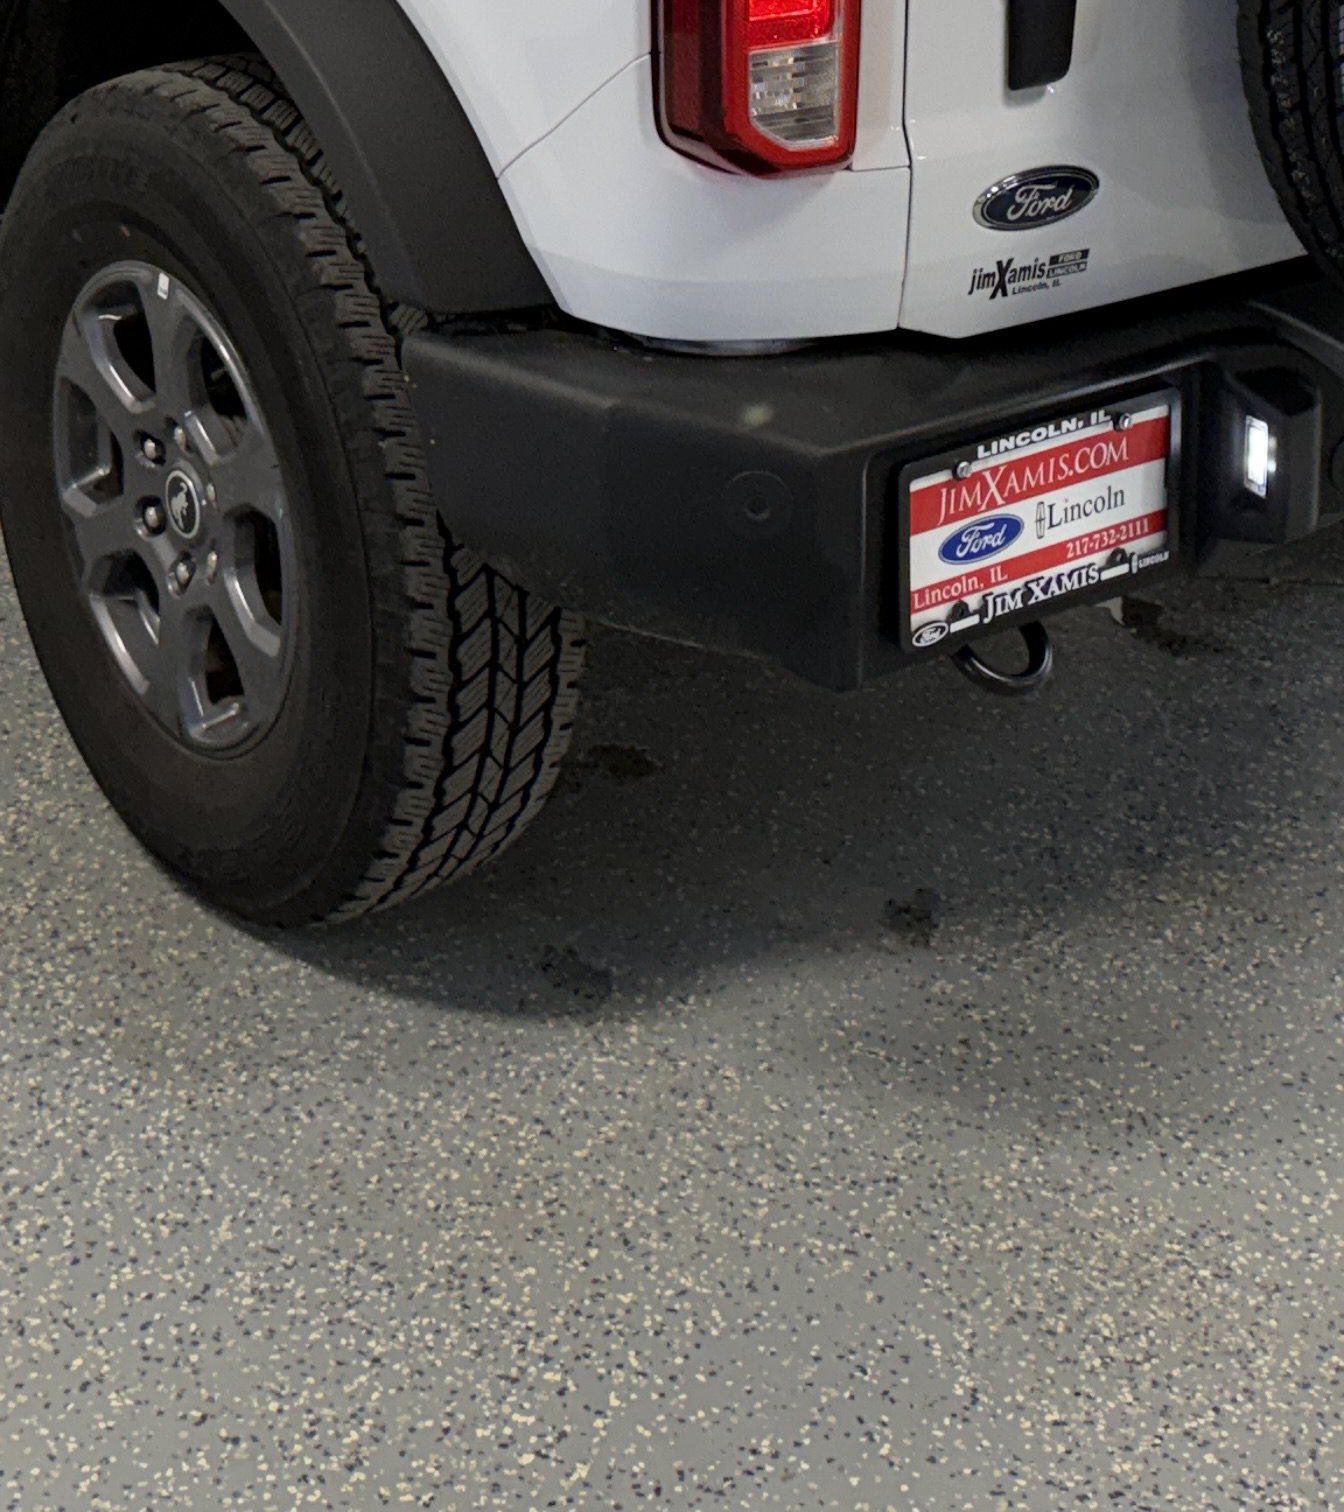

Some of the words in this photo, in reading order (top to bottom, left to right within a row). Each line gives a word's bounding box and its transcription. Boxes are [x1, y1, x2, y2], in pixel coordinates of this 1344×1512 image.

[1008, 182, 1076, 221] Ford
[977, 415, 1085, 459] LINCOLN,
[1090, 408, 1112, 425] IL
[937, 436, 1130, 526] JIMXAMIS.COM
[1046, 484, 1126, 530] Lincoln
[955, 522, 1006, 557] Ford
[1066, 518, 1150, 559] 217-732-2111
[912, 572, 984, 609] Lincoln,
[989, 565, 1008, 586] IL
[983, 589, 1025, 624] JIM
[1025, 562, 1100, 605] XAMIS
